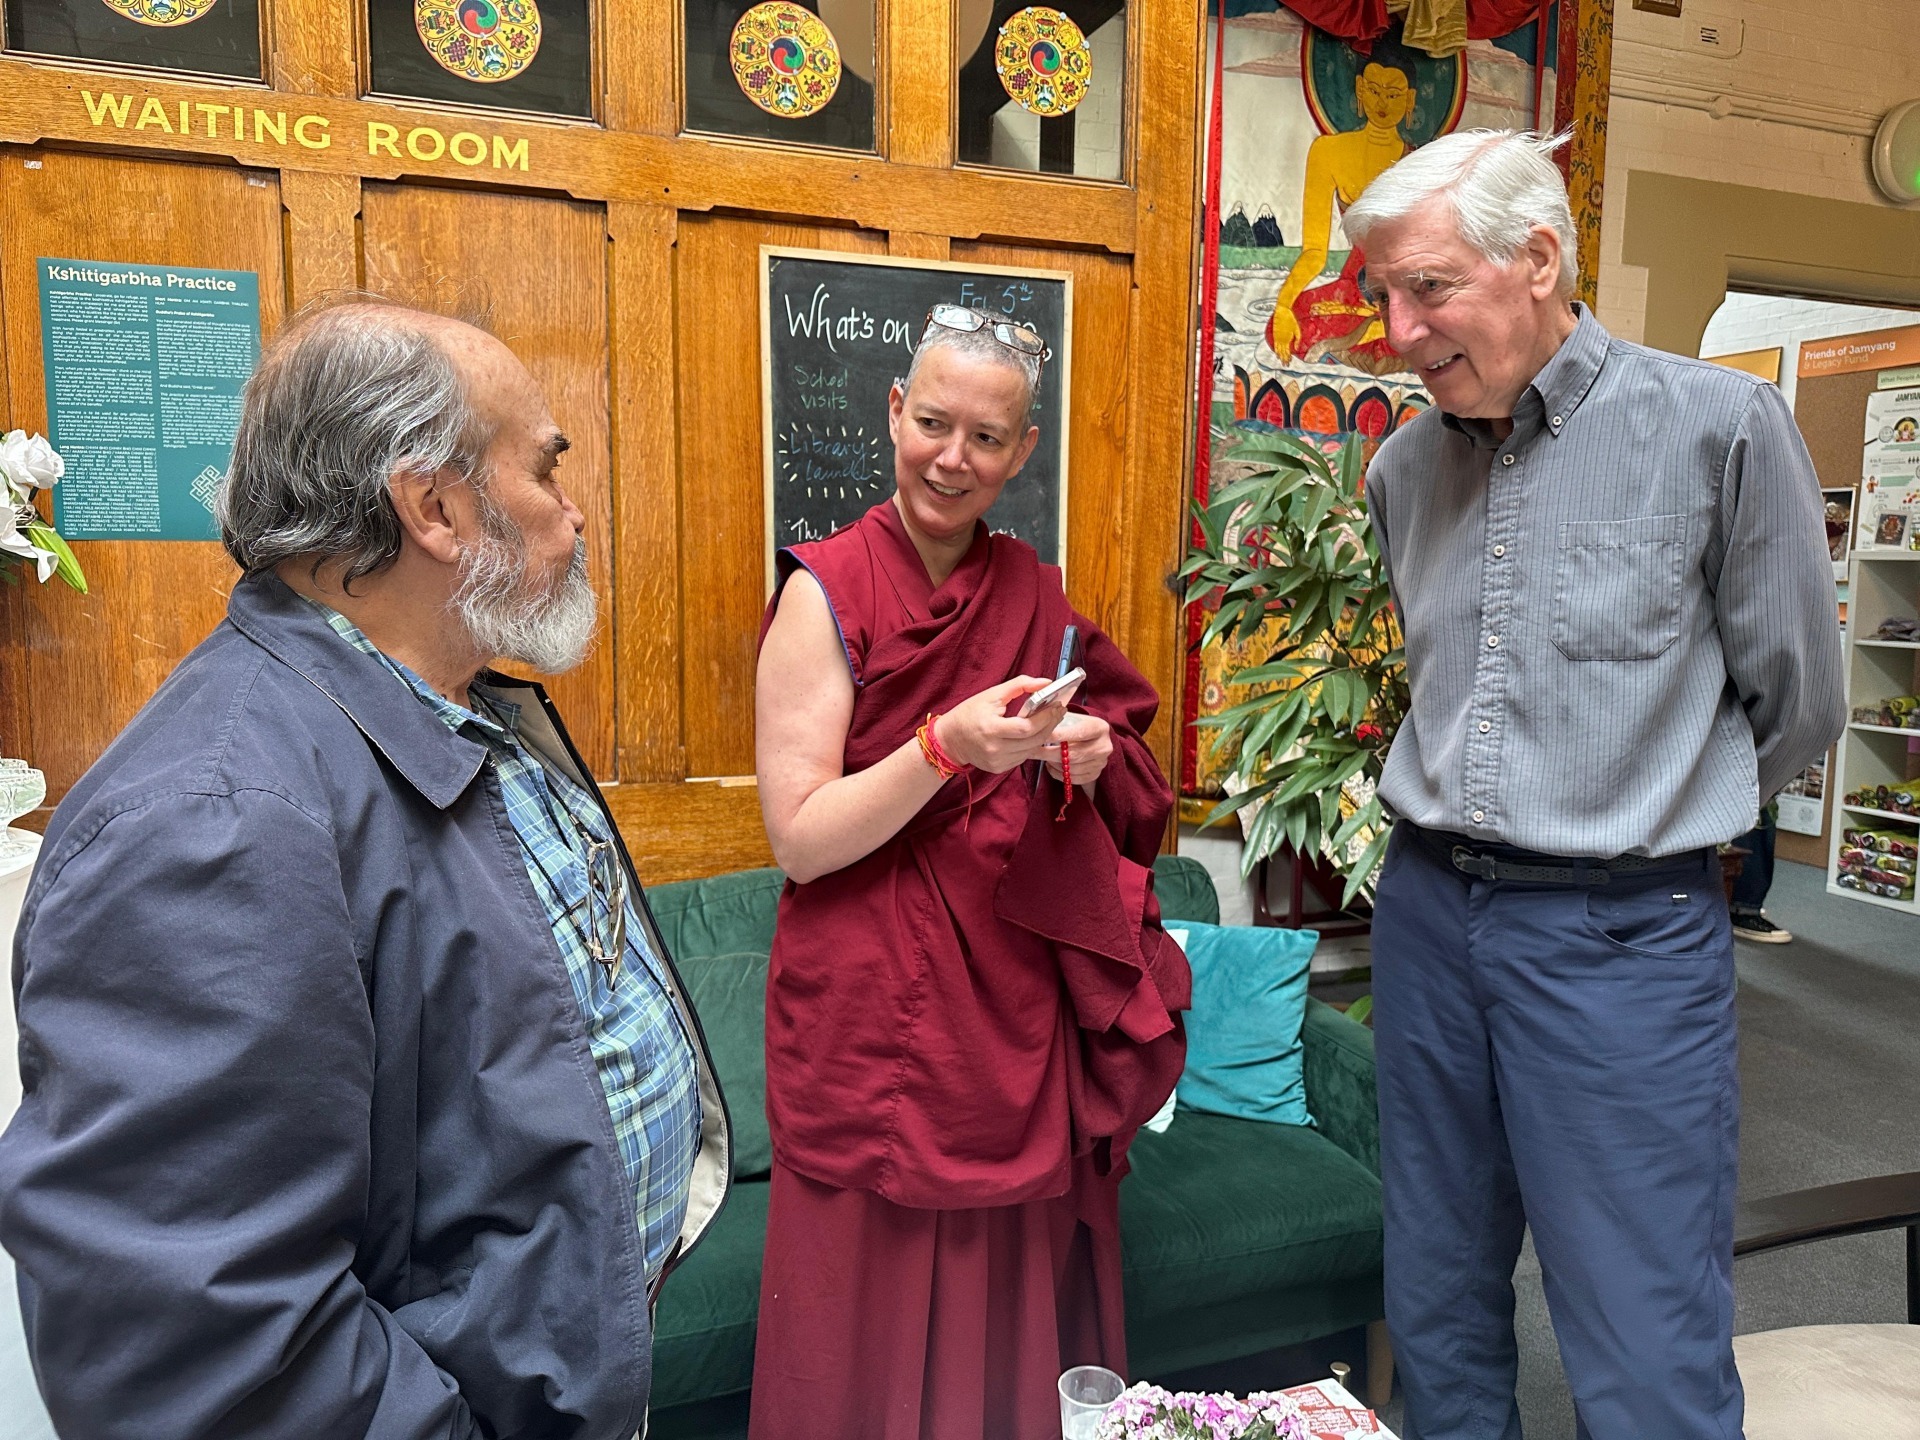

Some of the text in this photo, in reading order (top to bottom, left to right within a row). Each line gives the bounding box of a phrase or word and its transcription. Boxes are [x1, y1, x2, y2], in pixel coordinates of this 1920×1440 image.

[80, 90, 531, 172] WAITING ROOM
[47, 265, 237, 292] Kshitigarbha Practice
[784, 283, 915, 356] What's on
[1805, 341, 1896, 361] Friends of Jamyang
[1812, 357, 1842, 370] Legacy
[1844, 353, 1869, 364] Fund
[794, 365, 848, 388] School
[801, 391, 848, 410] visits
[790, 432, 868, 466] Library
